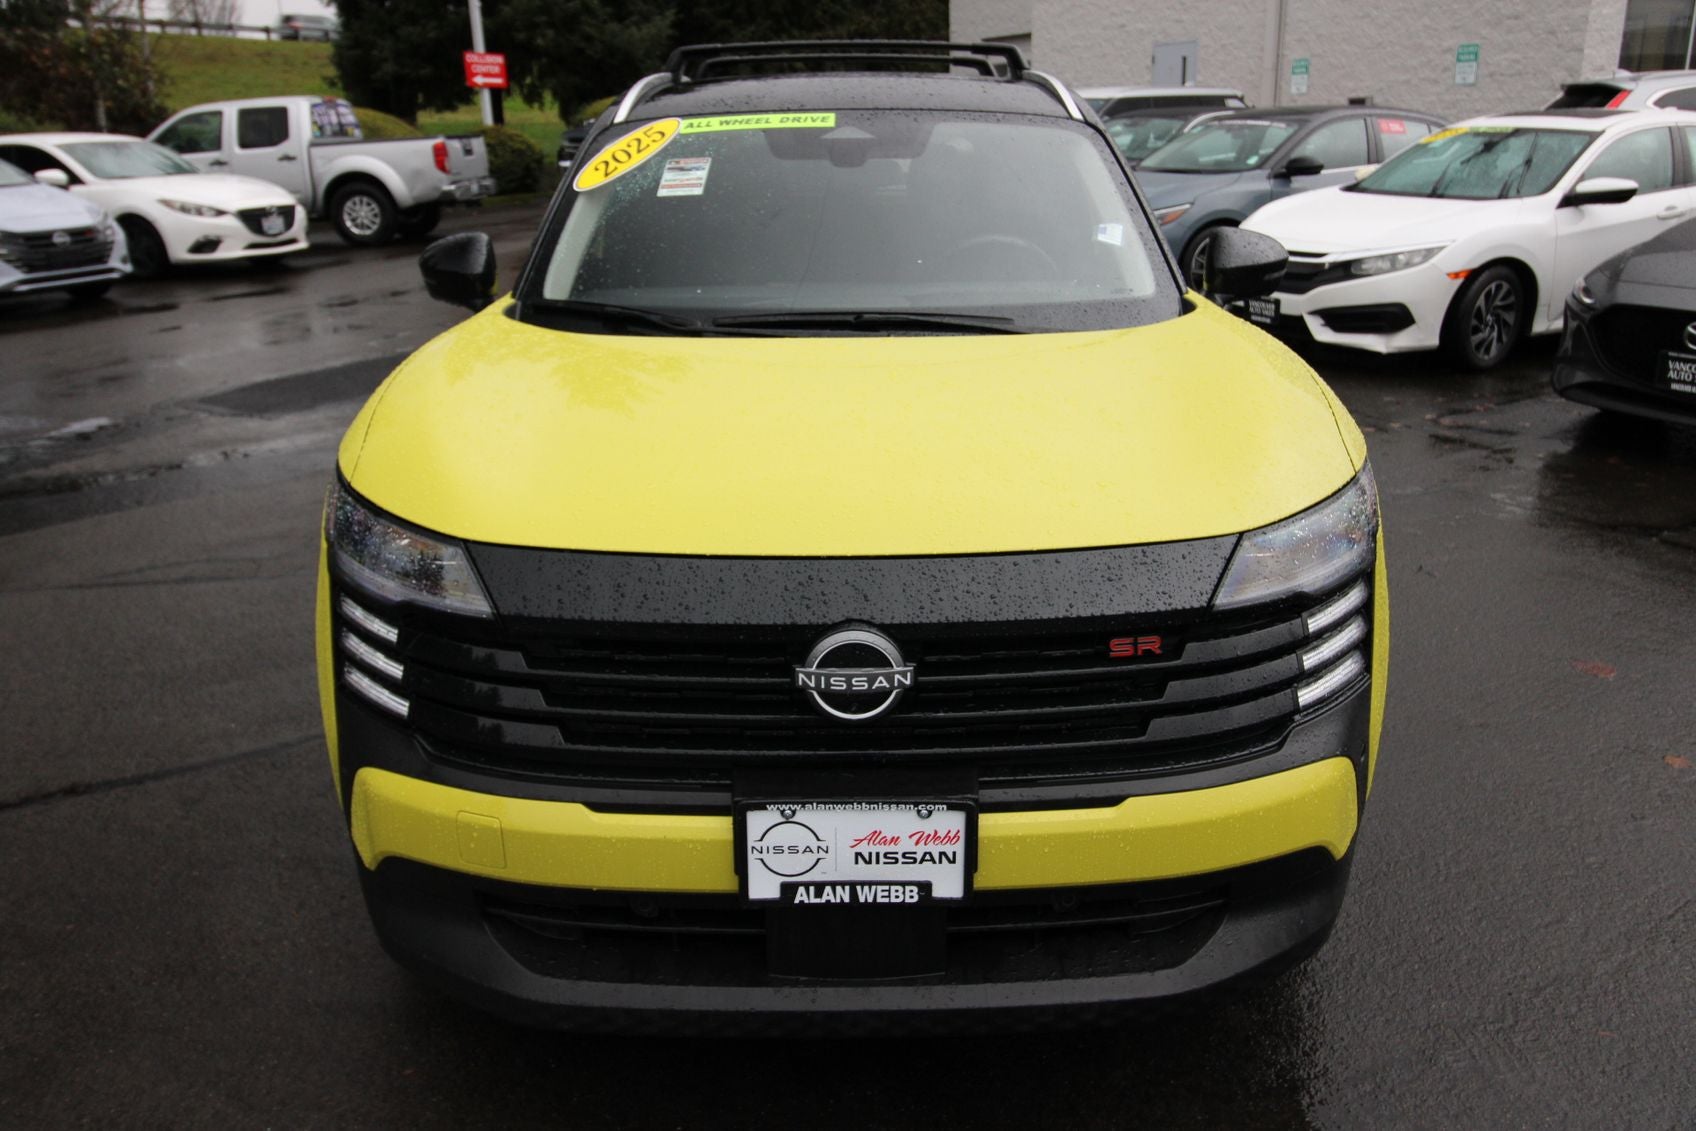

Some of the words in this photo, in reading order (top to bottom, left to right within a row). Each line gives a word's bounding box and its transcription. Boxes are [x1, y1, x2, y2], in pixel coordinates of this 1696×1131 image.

[683, 121, 712, 130] ALL
[719, 117, 772, 126] WHEEL
[779, 115, 830, 124] DRIVE
[594, 126, 666, 177] 2025
[1667, 369, 1693, 382] AUTO
[1109, 634, 1163, 658] SR
[797, 671, 912, 690] NISSAN
[765, 802, 948, 813] www.alanwebbnissan.com
[849, 830, 901, 849] Alan
[908, 828, 962, 847] Webb
[751, 845, 830, 855] NISSAN
[854, 850, 957, 865] NISSAN
[793, 885, 850, 904] ALAN
[856, 885, 920, 903] WEBB
